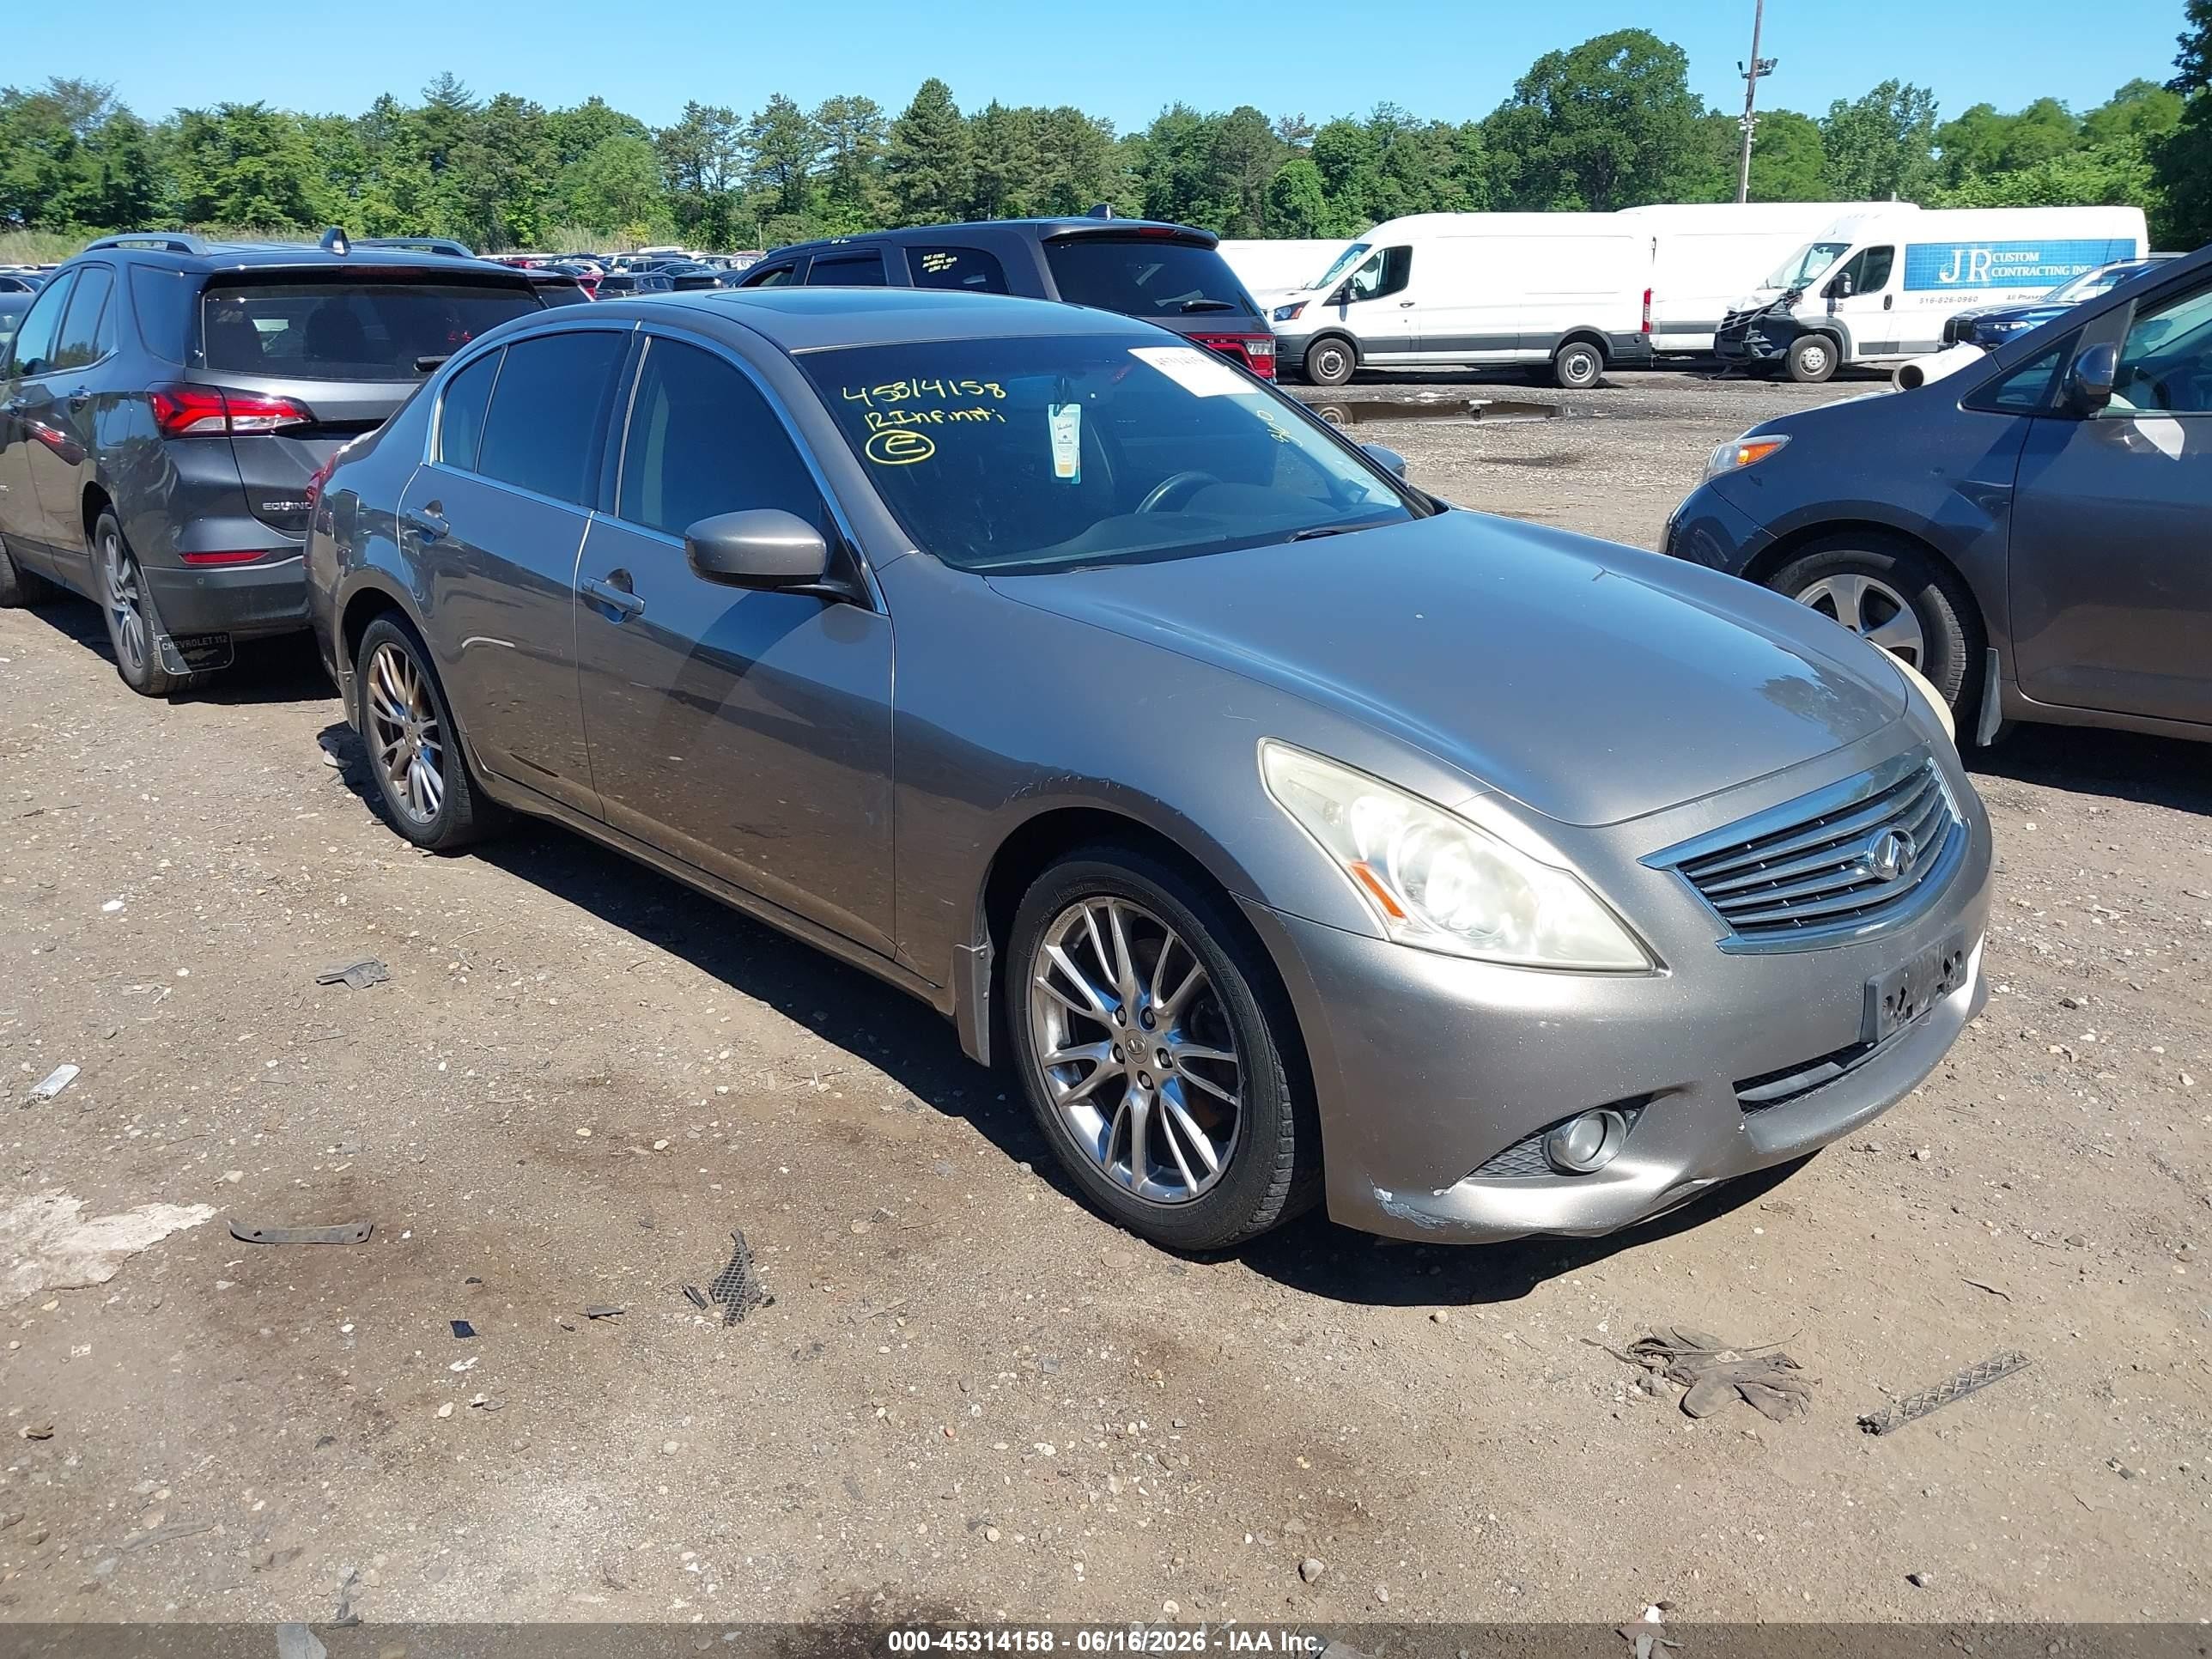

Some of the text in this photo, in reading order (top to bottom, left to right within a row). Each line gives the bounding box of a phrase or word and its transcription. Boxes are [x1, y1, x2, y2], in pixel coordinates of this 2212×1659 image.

[1992, 252, 2040, 263] CUSTOM
[1936, 248, 1992, 283] JR
[1990, 264, 2070, 277] CONTRACTING
[842, 378, 1007, 407] 45314158
[262, 501, 313, 511] EQUINO
[161, 636, 213, 651] CHEVROLET
